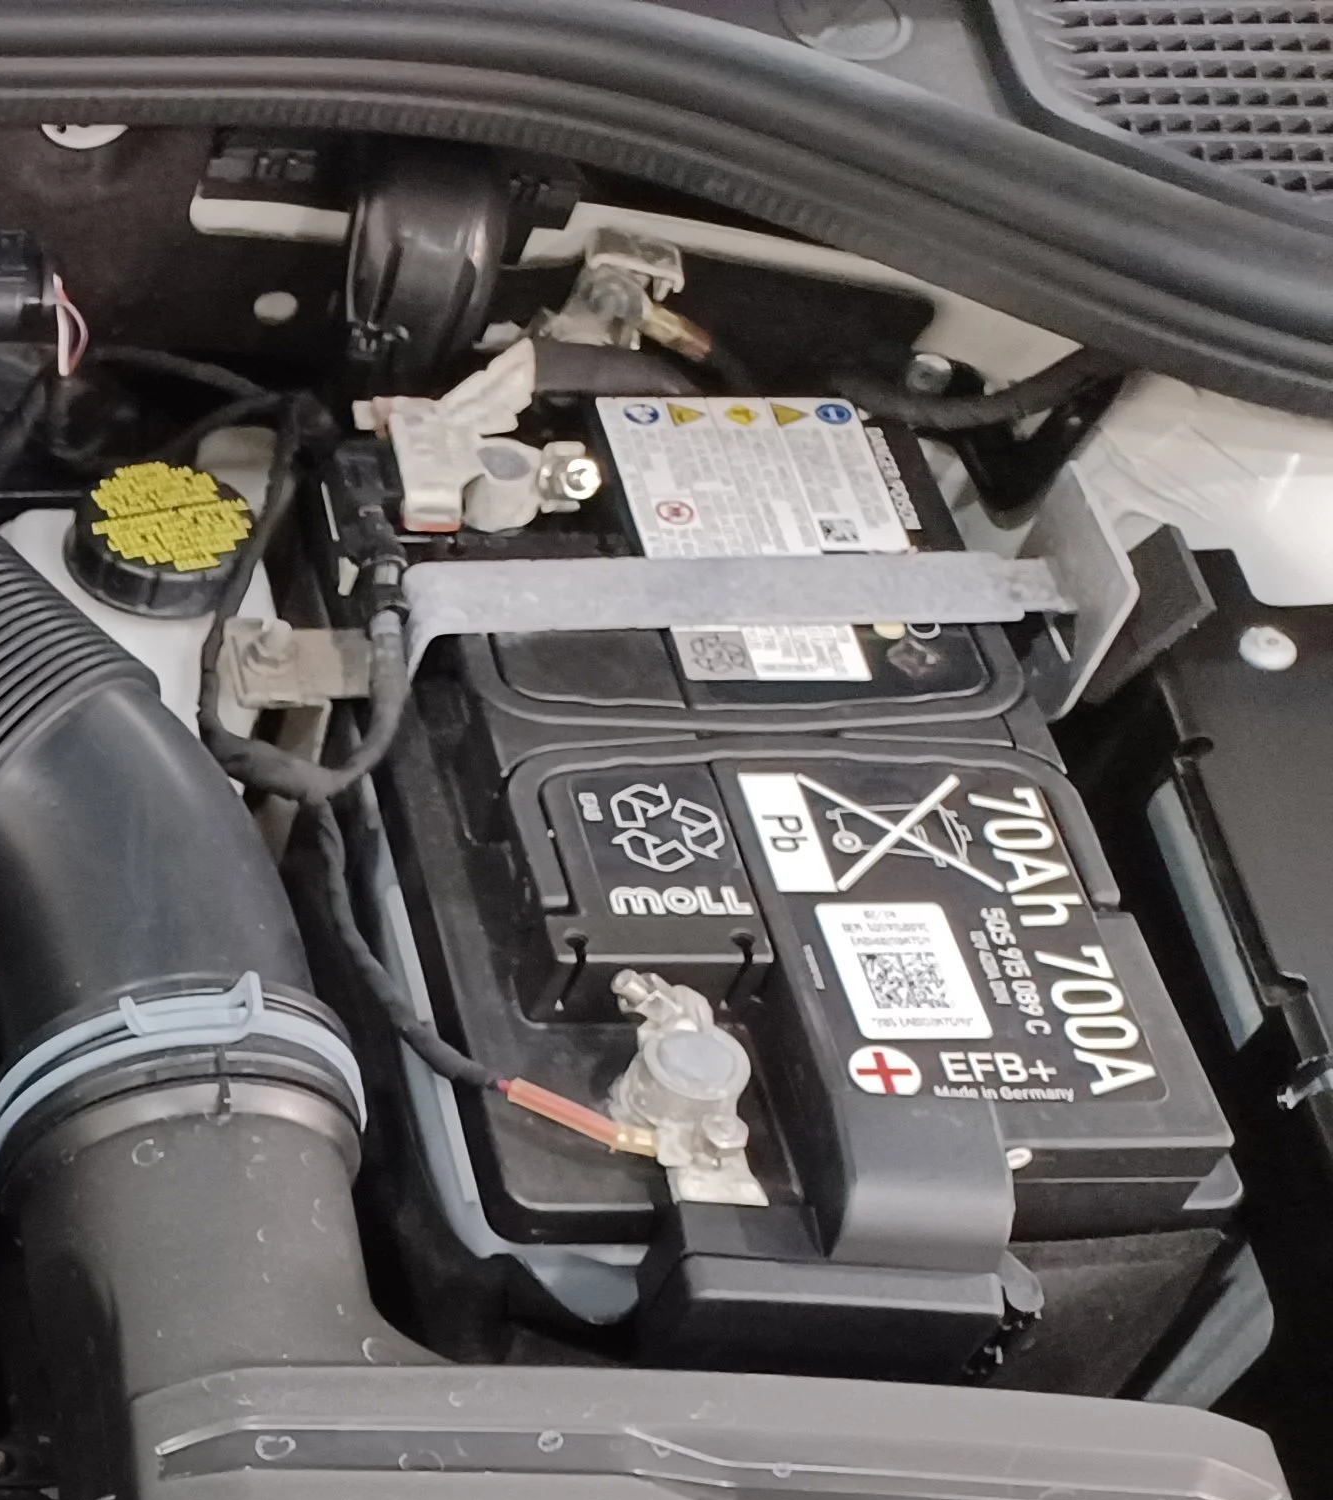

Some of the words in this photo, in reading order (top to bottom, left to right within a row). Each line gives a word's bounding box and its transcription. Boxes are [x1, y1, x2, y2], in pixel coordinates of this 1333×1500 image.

[763, 814, 809, 854] Pb
[967, 787, 1084, 927] 70Ah
[1035, 945, 1156, 1095] 700A
[1025, 1019, 1052, 1035] C
[939, 1052, 1057, 1083] EFB+
[934, 1085, 979, 1100] Made
[981, 1085, 998, 1100] in
[1000, 1086, 1074, 1102] Germany
